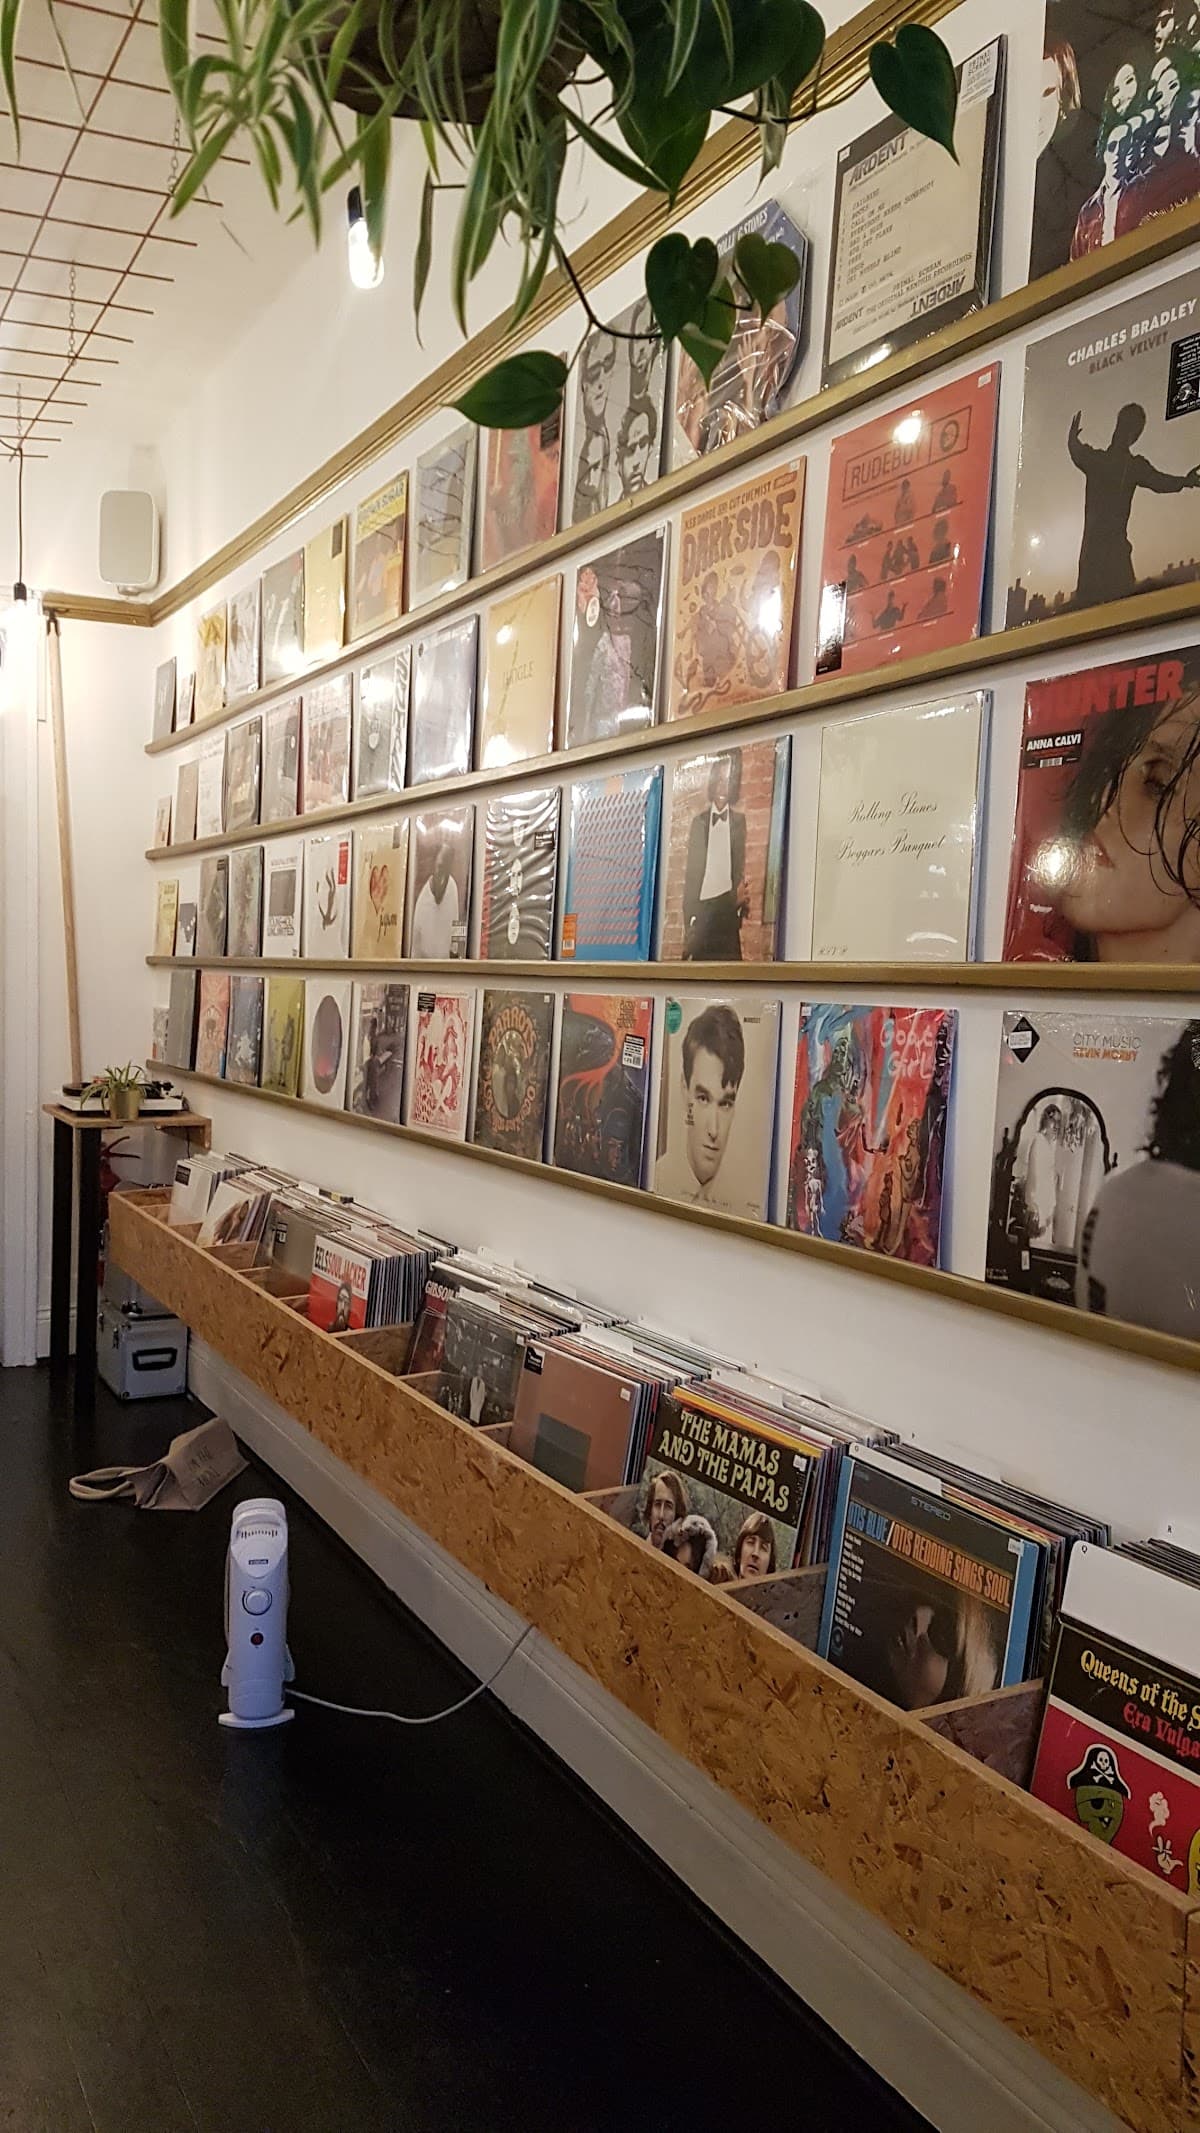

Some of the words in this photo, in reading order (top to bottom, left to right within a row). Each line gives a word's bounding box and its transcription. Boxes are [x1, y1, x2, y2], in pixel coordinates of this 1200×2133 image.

[849, 131, 910, 185] ARDENT
[910, 276, 966, 318] ARDENT
[1067, 329, 1127, 367] CHARLES
[1131, 298, 1198, 339] BRADLEY
[1089, 351, 1124, 375] BLACK
[1130, 332, 1169, 357] VELVET
[729, 495, 741, 511] CUT
[742, 481, 772, 506] CHEMIST
[734, 489, 797, 553] SIDE
[1036, 660, 1185, 718] HUNTER
[1027, 737, 1053, 751] ANNA
[1054, 733, 1082, 749] CALVI
[848, 799, 892, 828] Rolling
[898, 790, 938, 815] Stones
[838, 838, 886, 866] Beggars
[889, 829, 947, 861] Banquet
[488, 1006, 537, 1059] PARROTS
[1073, 1032, 1100, 1047] CITY
[1103, 1034, 1142, 1050] MUSIC
[314, 1246, 329, 1273] EELS
[681, 1410, 711, 1445] THE
[714, 1421, 781, 1476] MAMAS
[658, 1430, 695, 1466] AND
[697, 1447, 731, 1485] THE
[730, 1467, 790, 1513] PAPAS
[911, 1496, 951, 1522] STEREO
[847, 1501, 866, 1532] OTIS
[866, 1510, 888, 1543] BLUE
[891, 1523, 915, 1556] OTIS
[912, 1533, 954, 1578] REDDING
[953, 1553, 985, 1594] SINGS
[983, 1570, 1011, 1608] SOUL
[1080, 1649, 1140, 1696] Queens
[1140, 1682, 1161, 1708] of
[1160, 1688, 1188, 1722] the
[1122, 1701, 1153, 1734] Era
